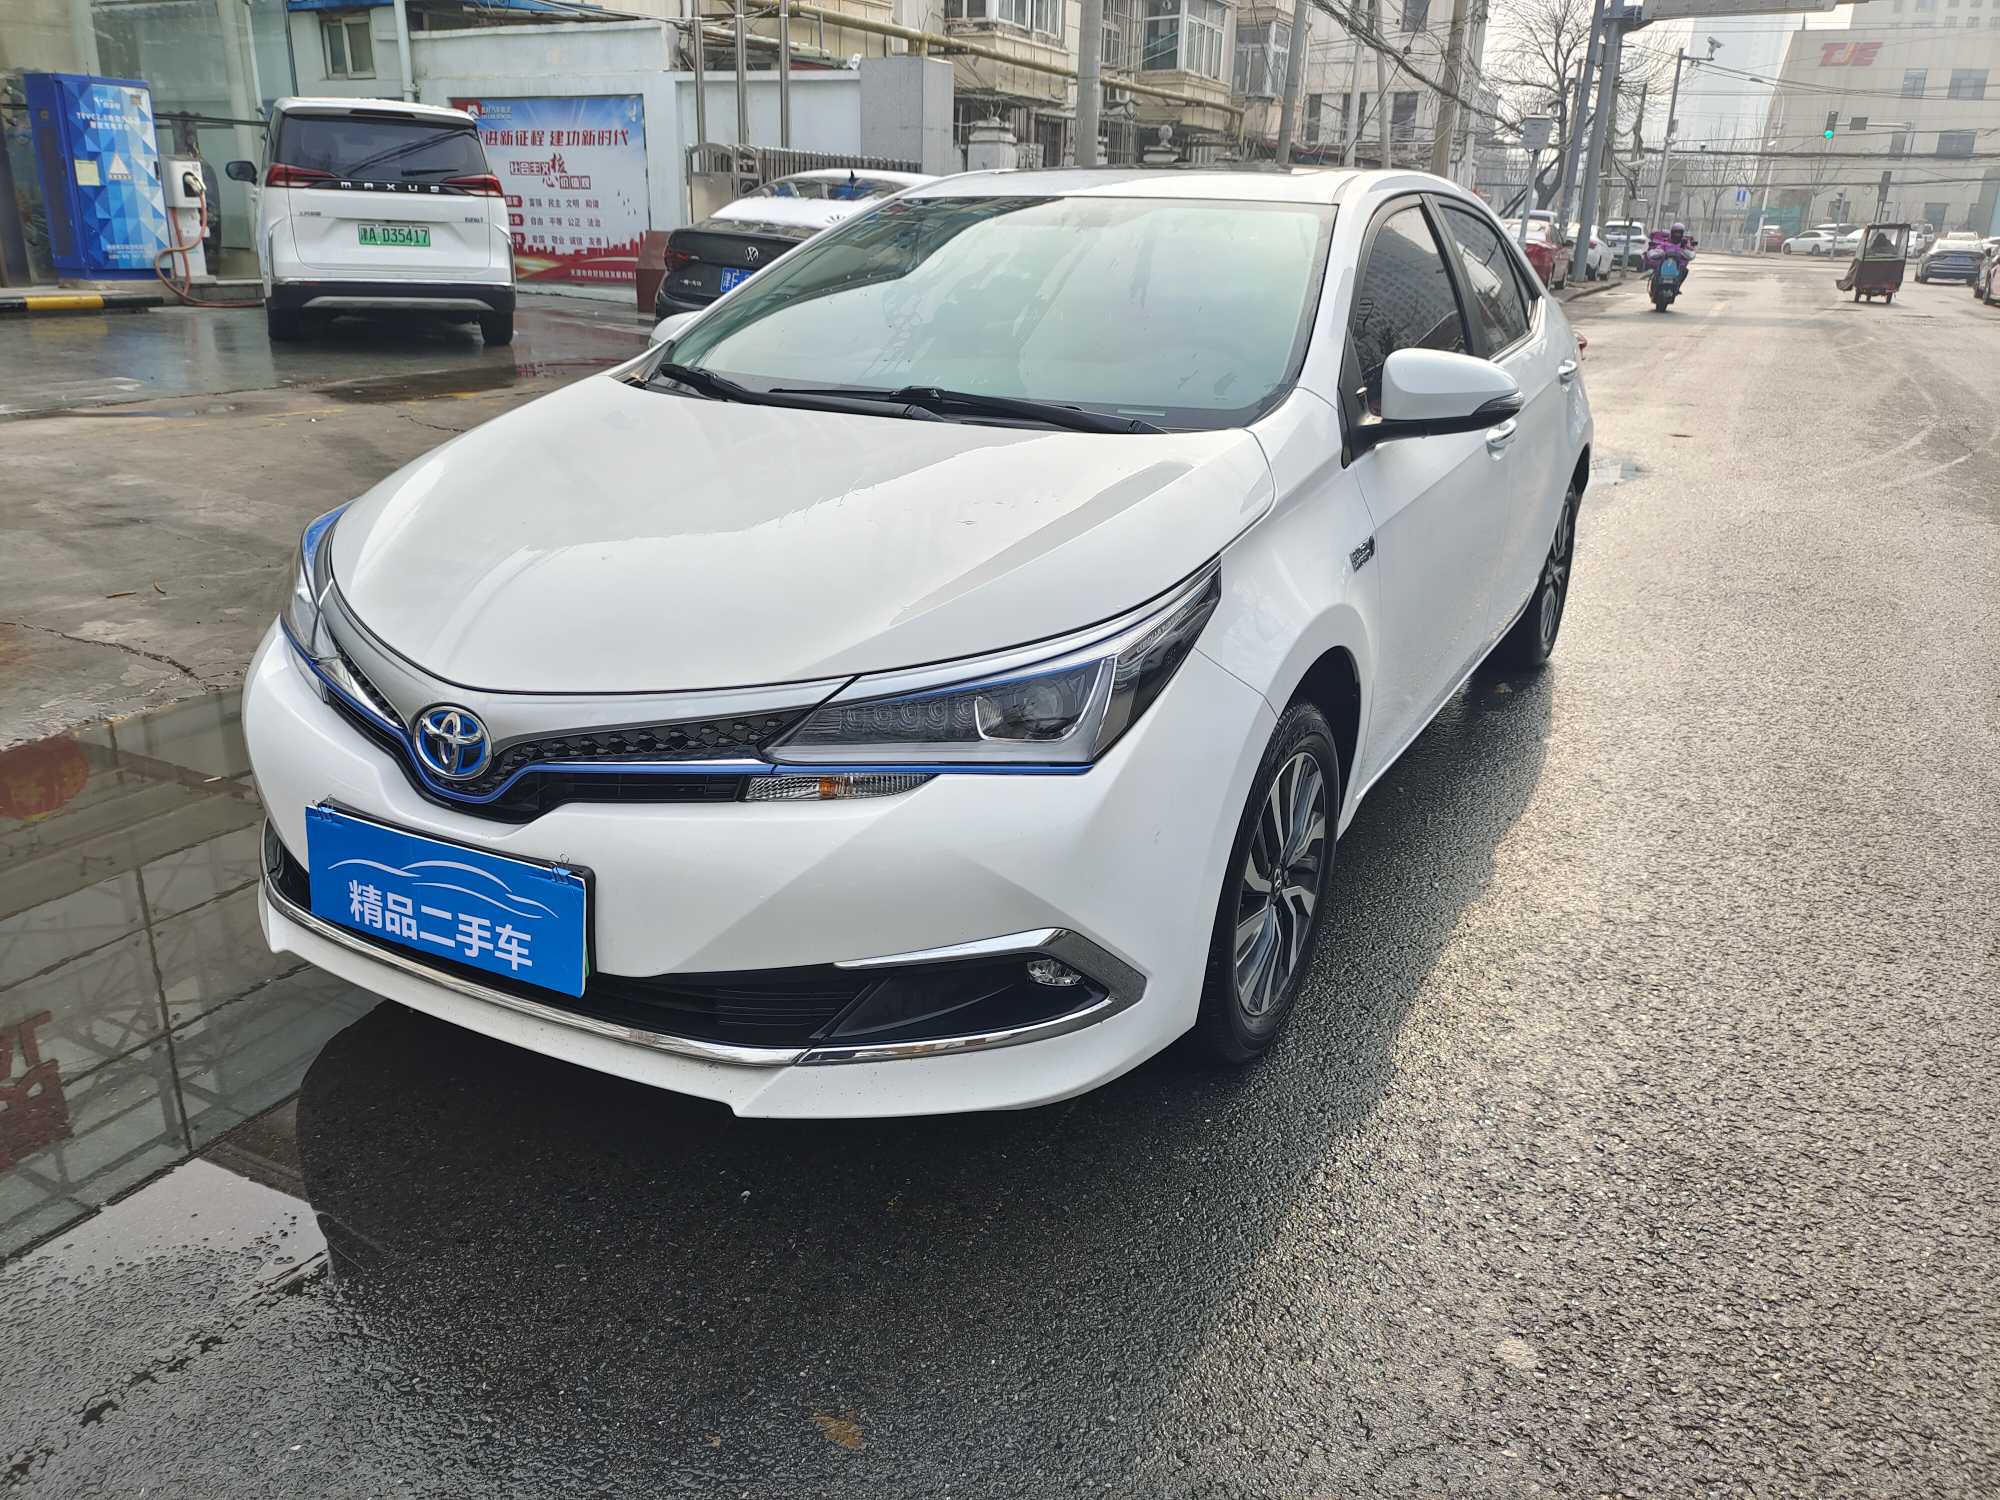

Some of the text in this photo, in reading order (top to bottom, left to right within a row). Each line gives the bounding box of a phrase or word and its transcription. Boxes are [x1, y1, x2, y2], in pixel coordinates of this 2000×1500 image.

[480, 127, 629, 147] 进新征程 建功新时代
[340, 181, 440, 193] MAXUS
[348, 879, 533, 972] 精品二手车
